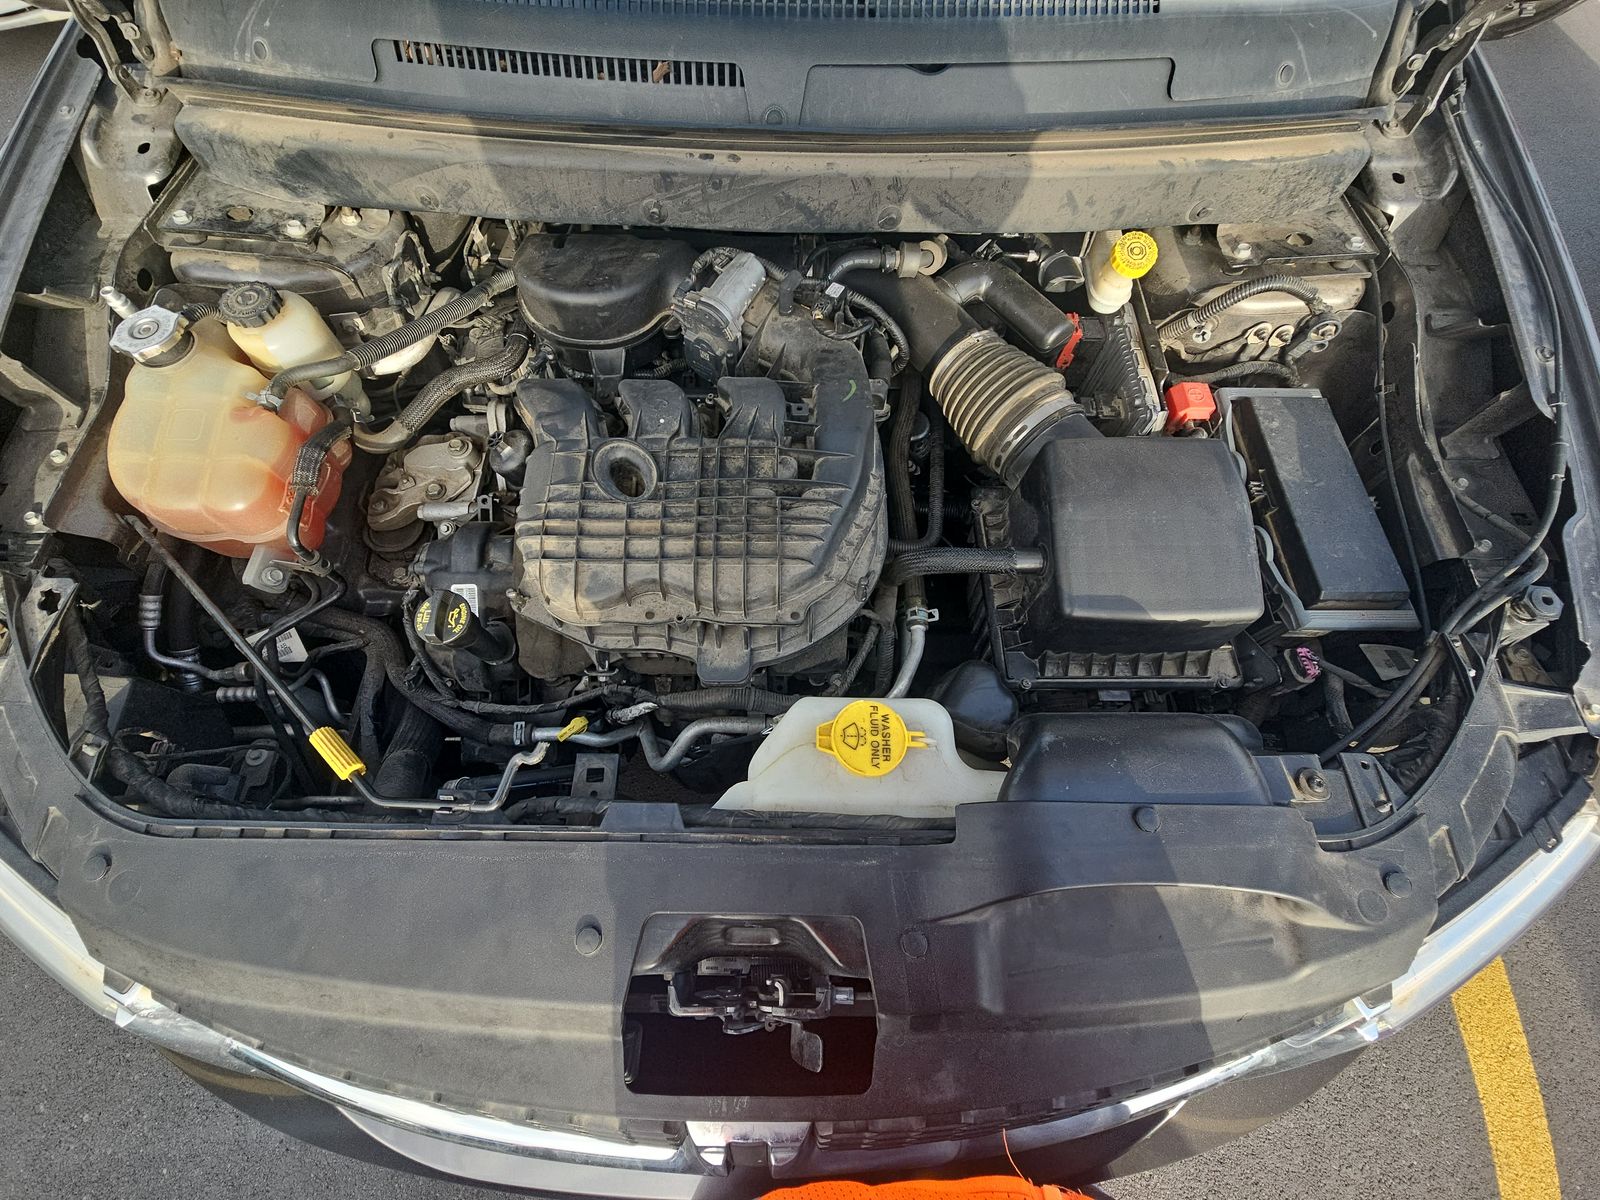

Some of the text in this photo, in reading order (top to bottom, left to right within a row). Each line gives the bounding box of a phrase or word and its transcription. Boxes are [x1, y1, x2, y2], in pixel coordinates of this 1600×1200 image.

[452, 624, 463, 633] OIL
[459, 603, 467, 624] ENGINE
[869, 705, 880, 769] FLUID ONLY
[881, 714, 891, 762] WASHER
